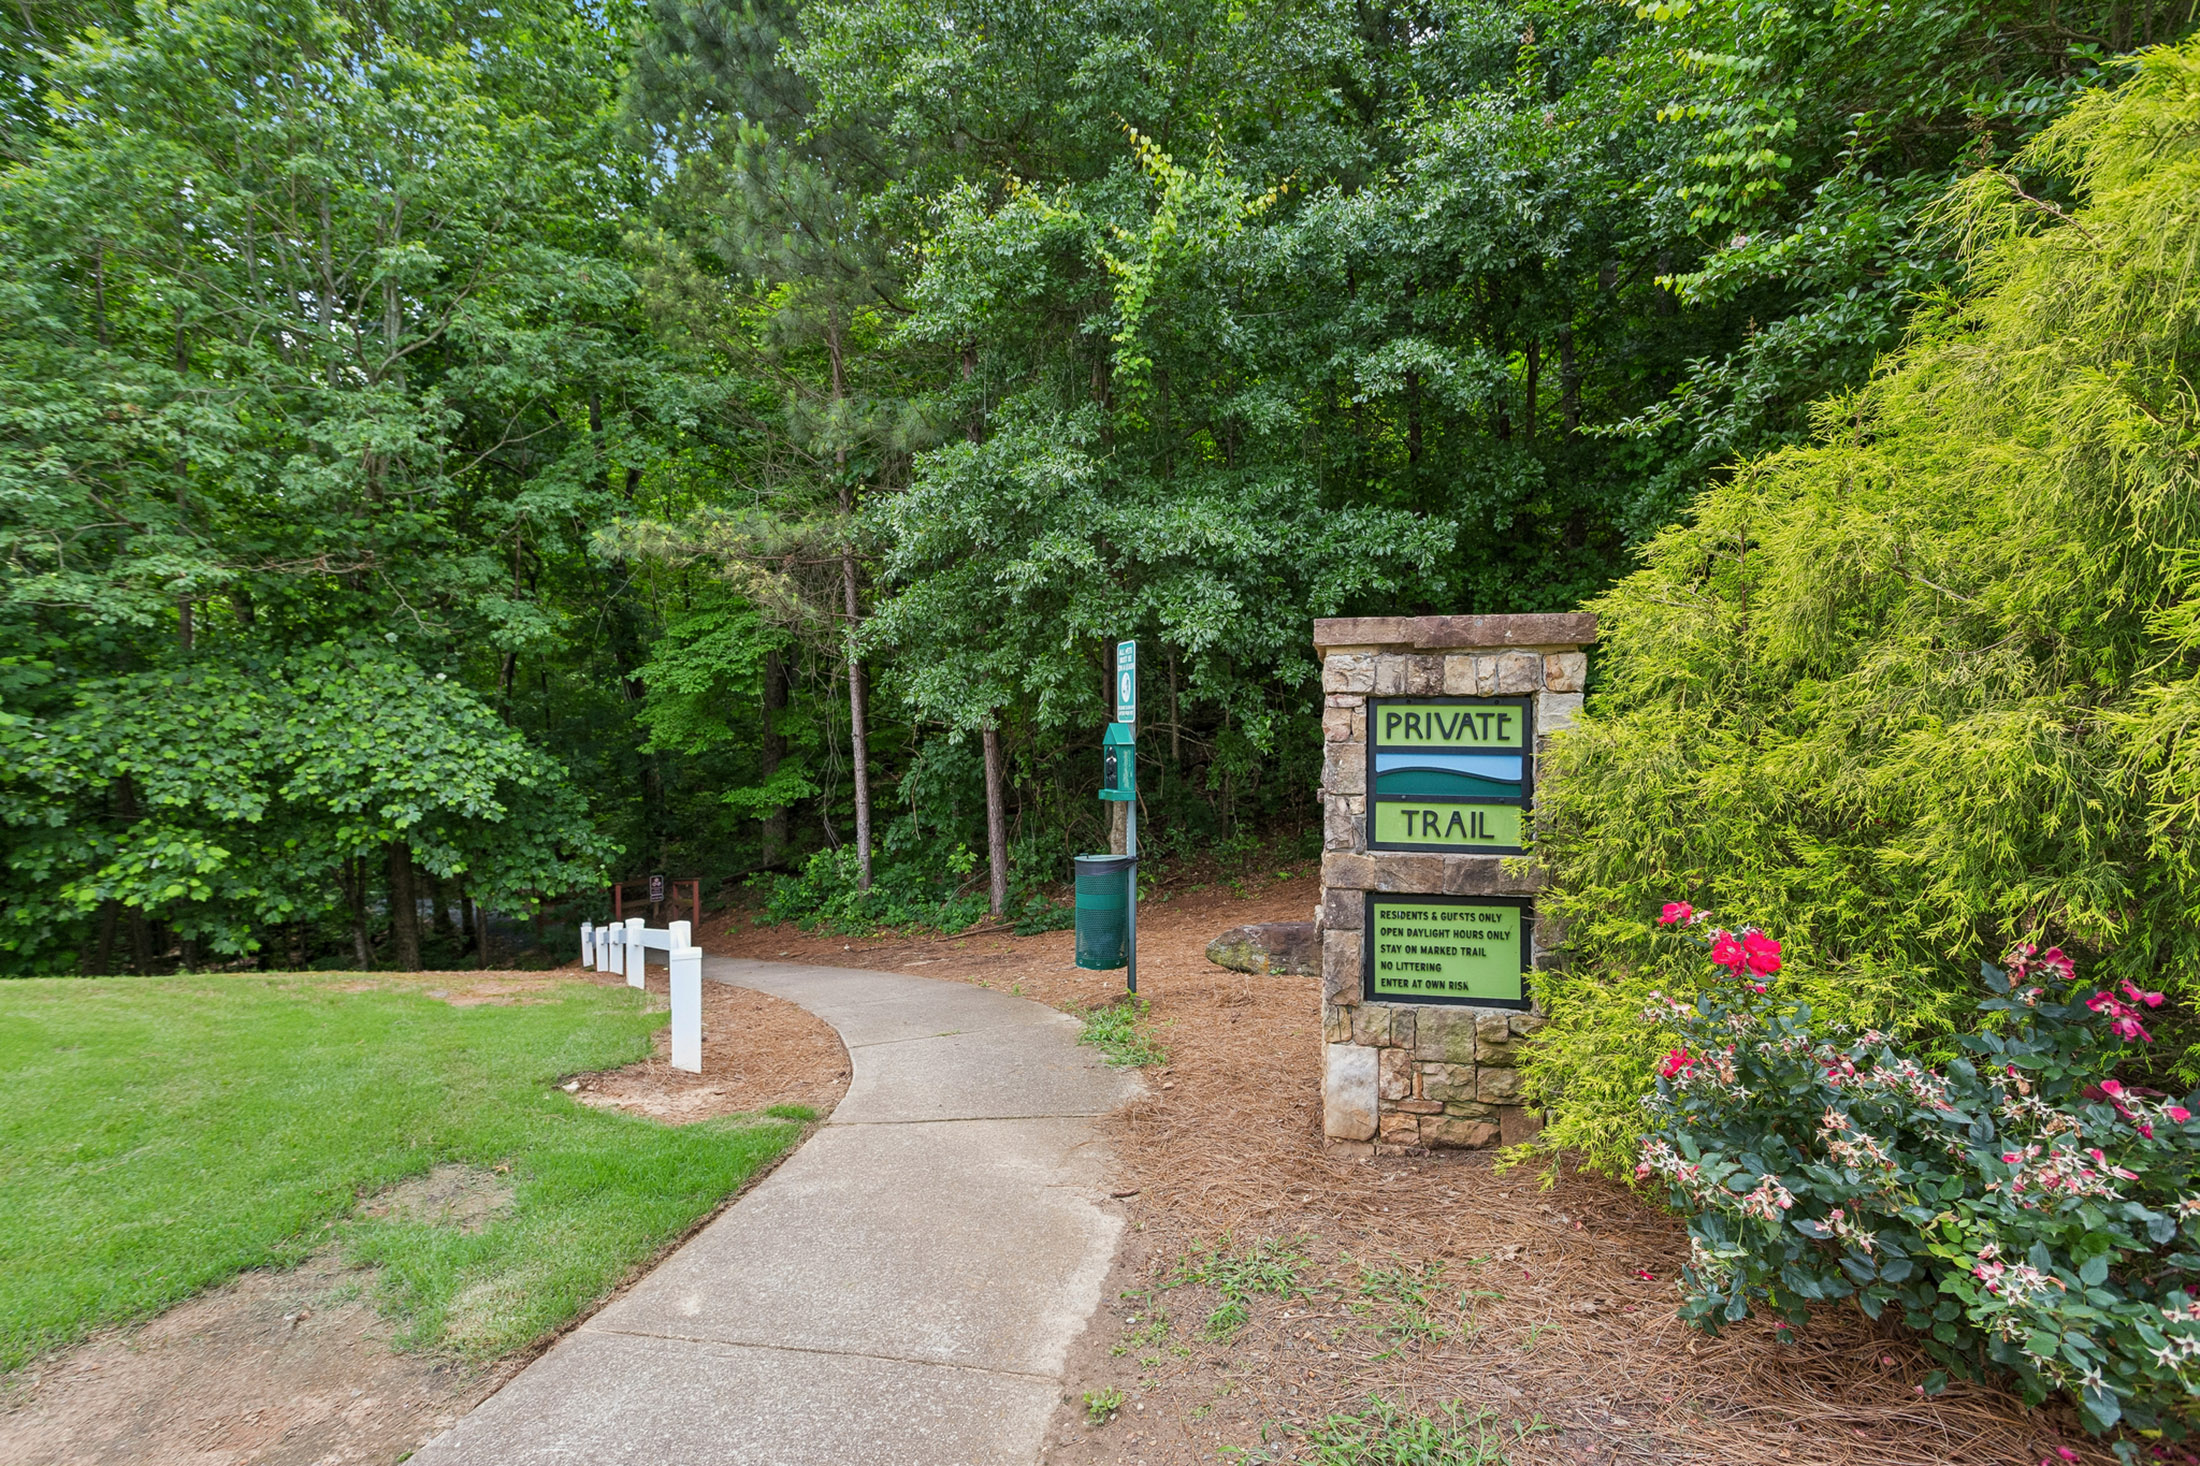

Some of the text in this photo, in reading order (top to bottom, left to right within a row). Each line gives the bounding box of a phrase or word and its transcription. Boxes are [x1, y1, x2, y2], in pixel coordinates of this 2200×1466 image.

[1386, 712, 1512, 740] PRIVATE
[1401, 810, 1495, 839] TRAIL
[1380, 910, 1502, 922] RESIDENTS & GUESTS ONLY
[1380, 928, 1510, 940] OPEN DAYLIGHT HOURS ONLY
[1380, 944, 1487, 957] STAY ON MARKED TRAIL
[1381, 961, 1441, 972] NO LITTERING
[1381, 978, 1469, 990] ENTER AT OWN RISK
